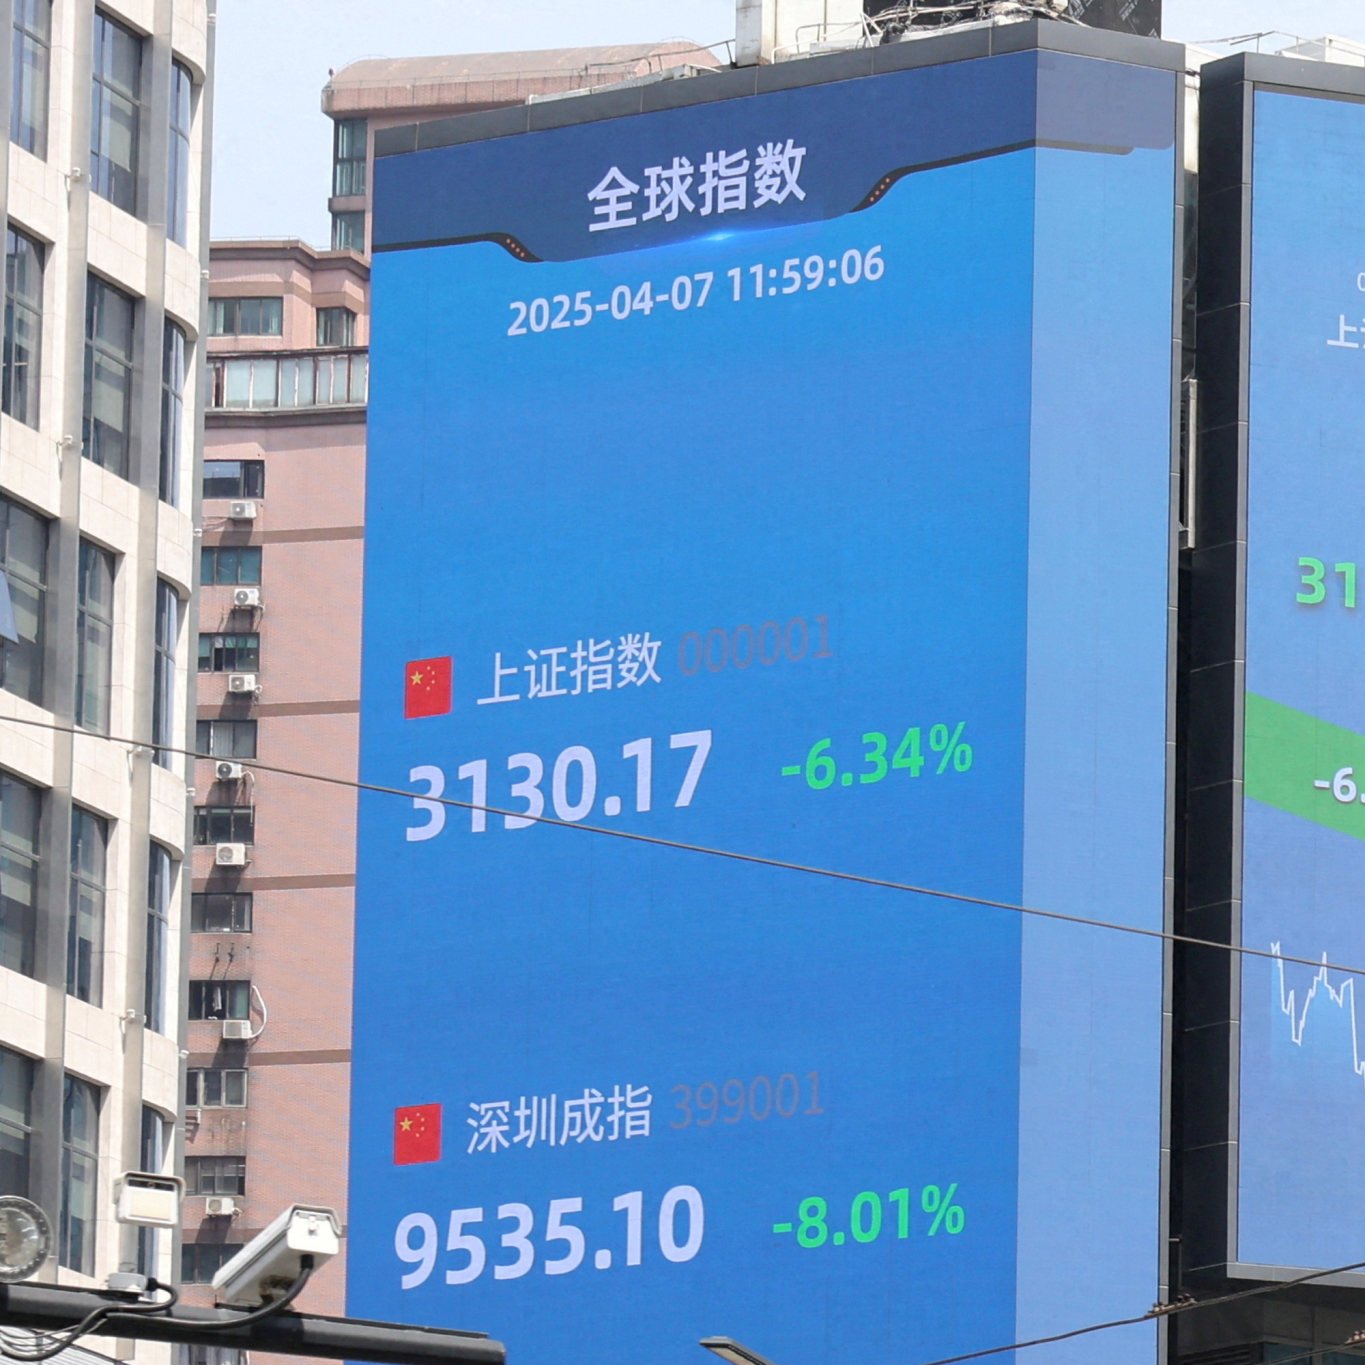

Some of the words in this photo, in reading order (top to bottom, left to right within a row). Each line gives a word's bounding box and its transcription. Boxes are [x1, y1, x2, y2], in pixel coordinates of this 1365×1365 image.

[588, 140, 808, 233] 全球指数
[506, 271, 713, 338] 2025-04-07
[727, 245, 886, 304] 11:59:06
[475, 631, 662, 706] 上证指数
[679, 614, 833, 676] 000001
[405, 730, 713, 843] 3130.17
[780, 721, 974, 790] -6.34%
[466, 1084, 653, 1155] 深圳成指
[670, 1071, 825, 1130] 399001
[394, 1184, 704, 1290] 9535.10
[772, 1183, 965, 1249] -8.01%
